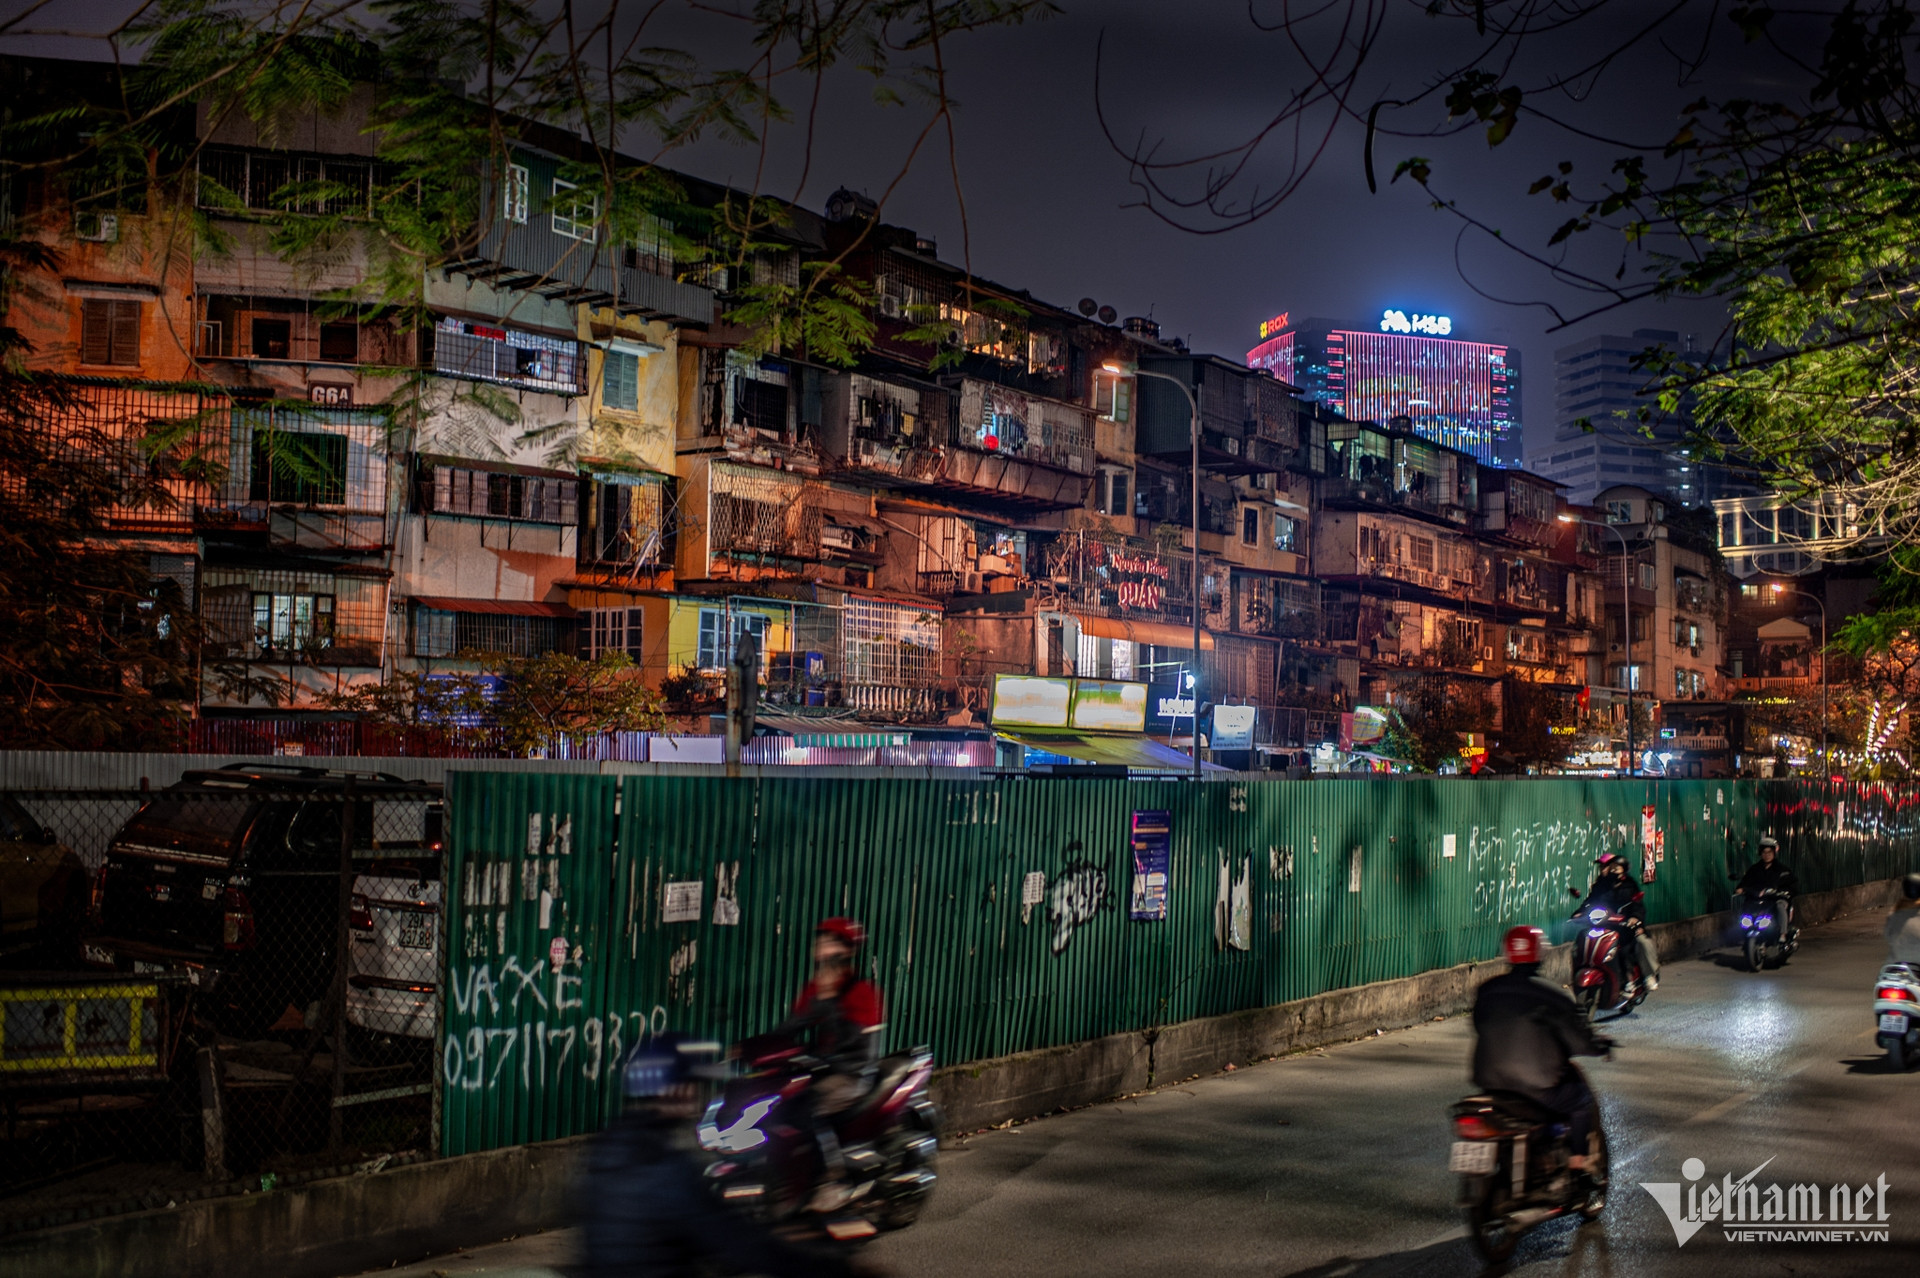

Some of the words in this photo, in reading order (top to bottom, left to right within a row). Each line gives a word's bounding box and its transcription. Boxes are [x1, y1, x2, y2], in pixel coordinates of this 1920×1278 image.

[1268, 311, 1289, 335] ROX
[1412, 314, 1451, 335] MSB
[312, 386, 349, 405] G6A
